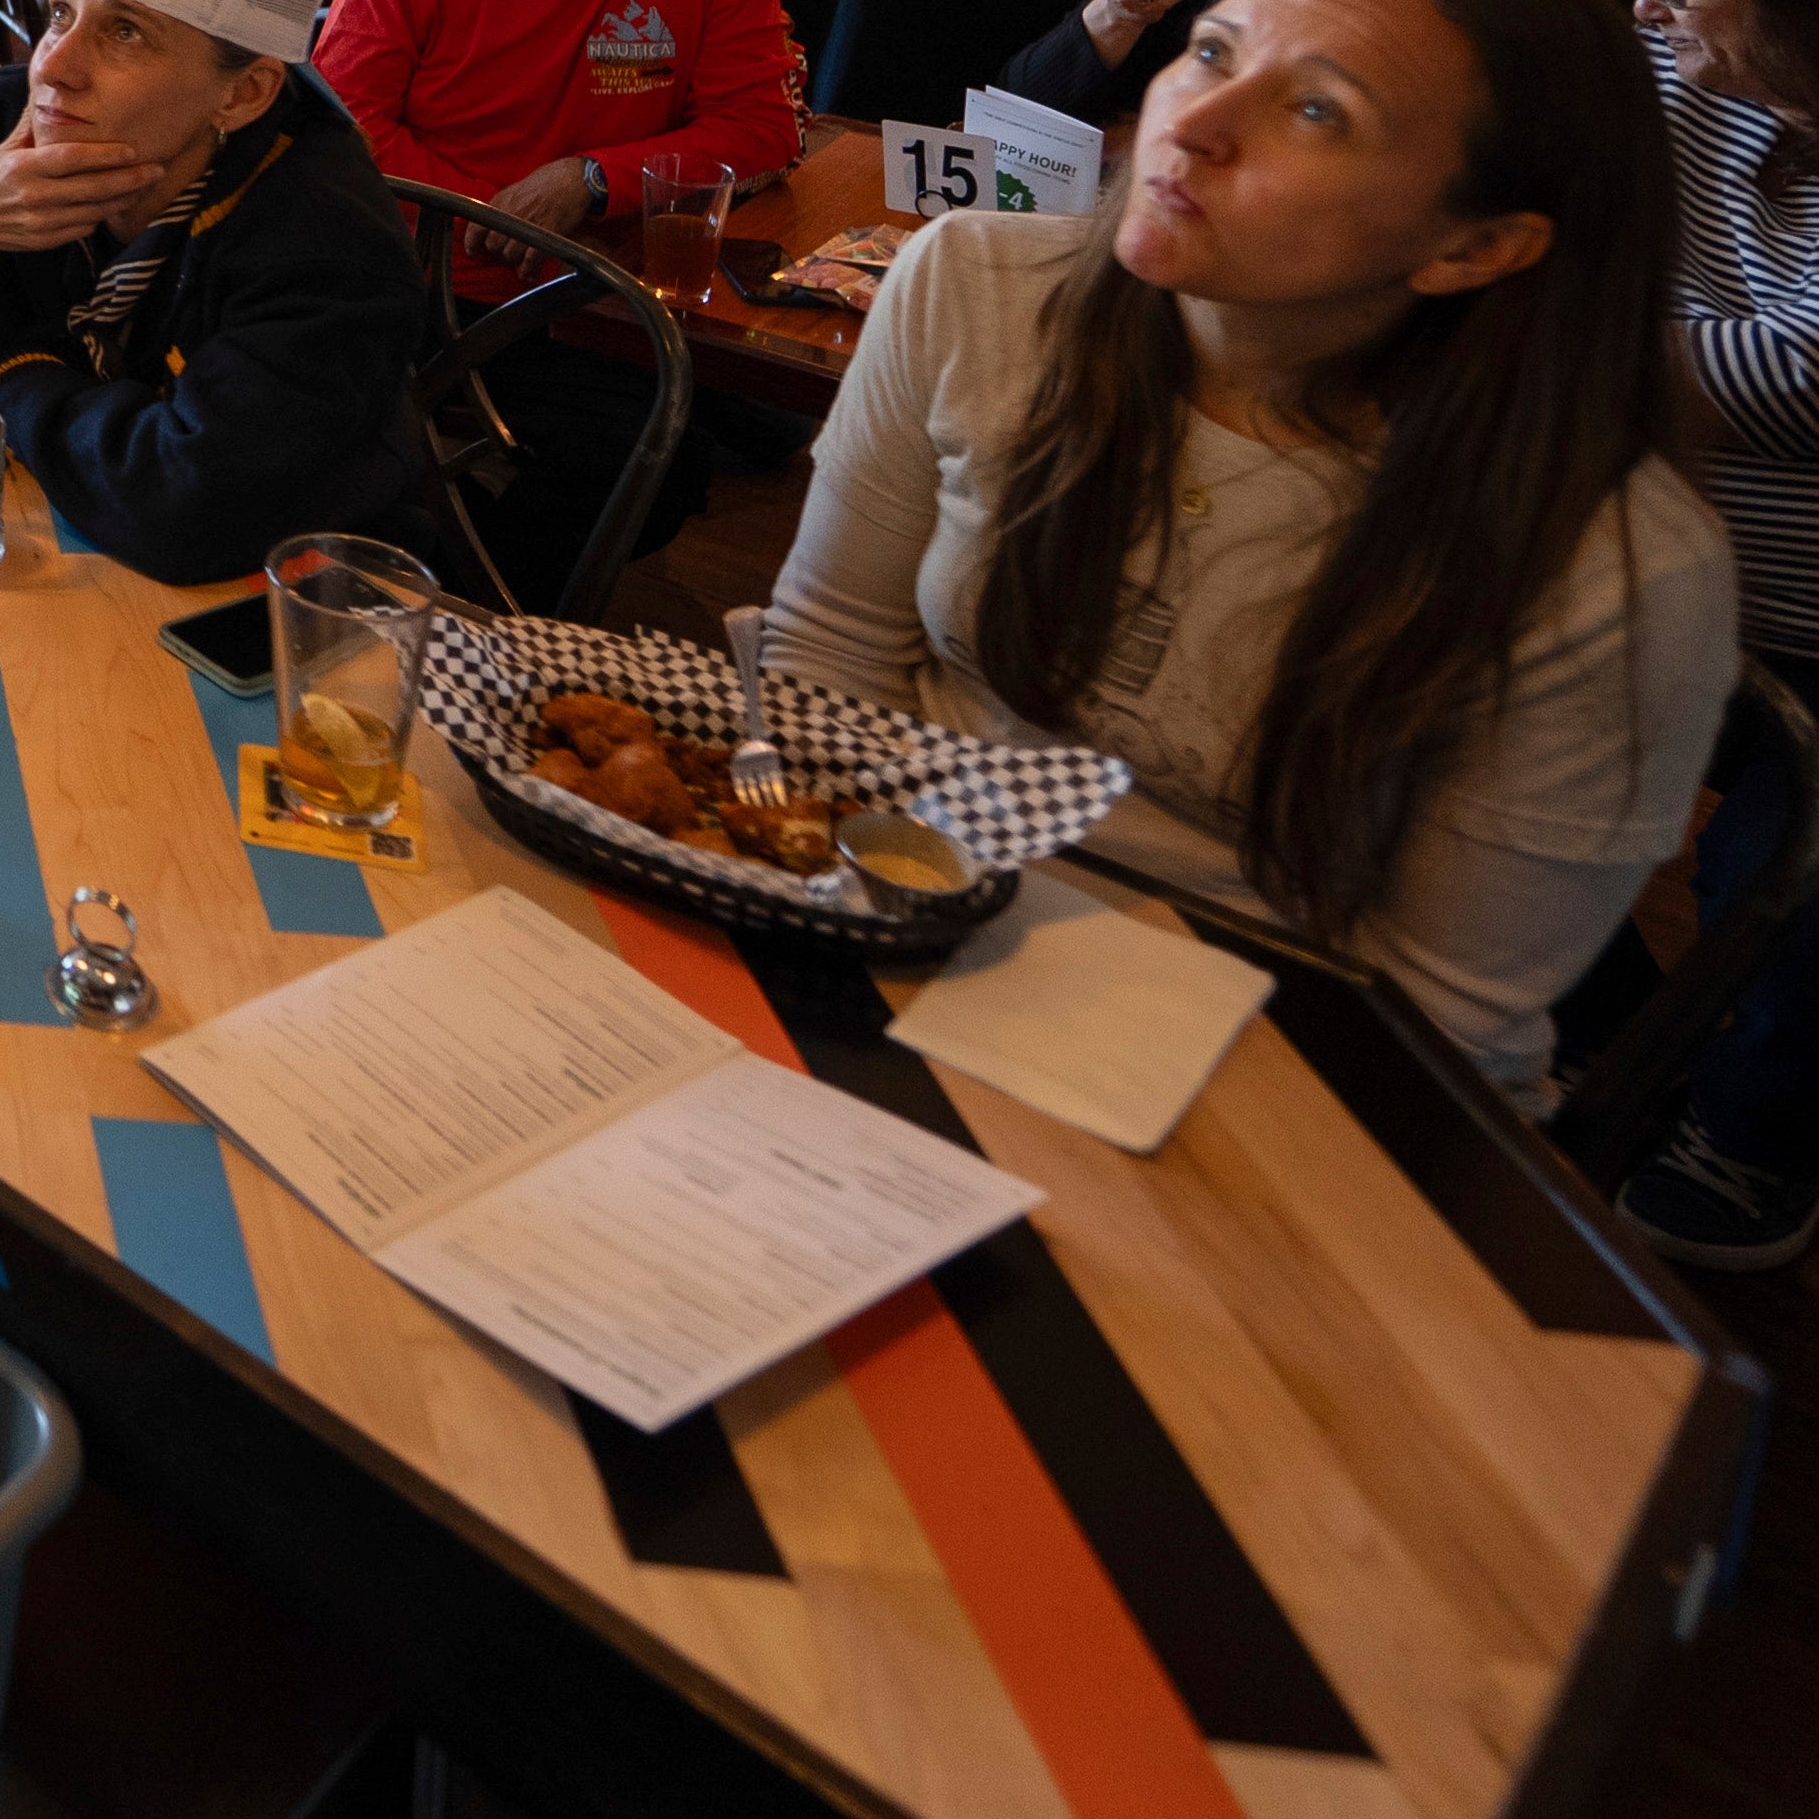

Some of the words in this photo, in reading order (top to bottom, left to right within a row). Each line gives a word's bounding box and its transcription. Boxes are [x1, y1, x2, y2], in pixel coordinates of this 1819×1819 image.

[587, 43, 672, 57] NAUTICA
[902, 138, 978, 209] 15
[1028, 152, 1078, 178] HOUR!
